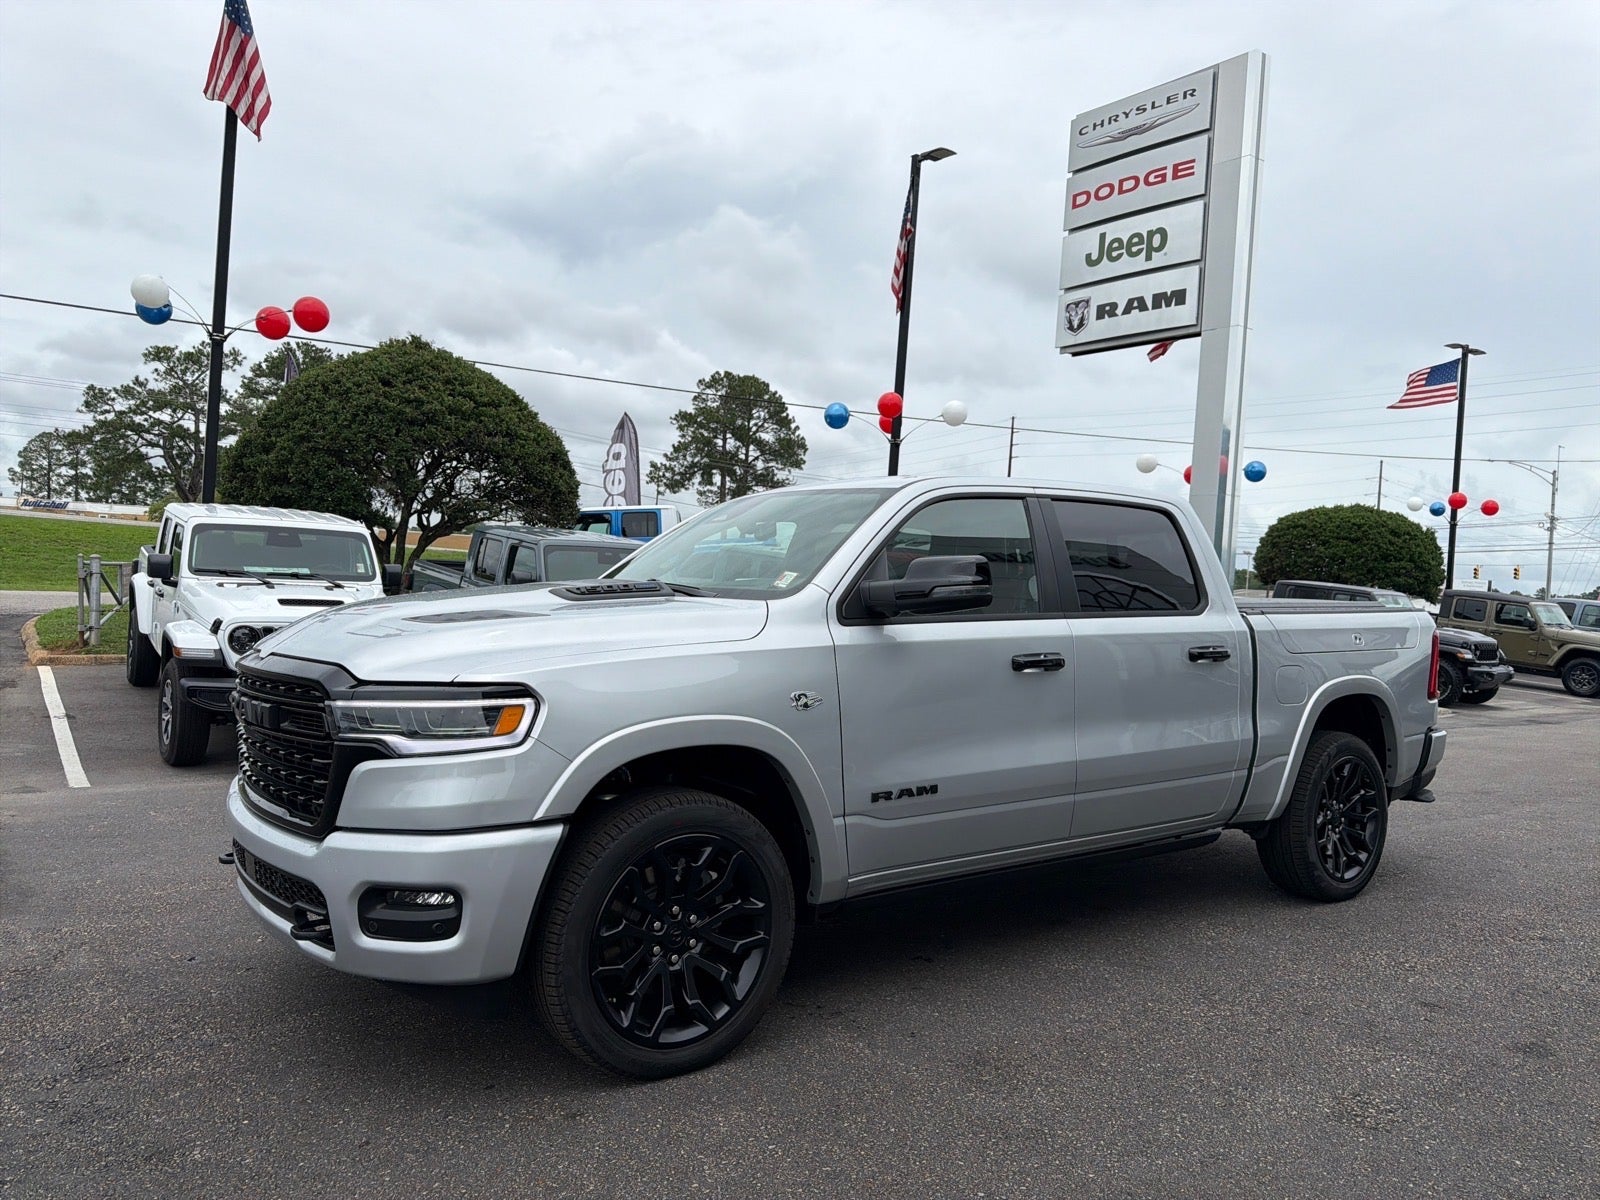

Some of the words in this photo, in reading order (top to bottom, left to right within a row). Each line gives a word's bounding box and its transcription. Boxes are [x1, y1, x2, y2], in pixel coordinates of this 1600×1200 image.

[1078, 88, 1198, 137] CHRYSLER
[1071, 158, 1197, 210] DODGE
[1084, 225, 1169, 268] Jeep
[1095, 288, 1187, 321] RAM
[870, 784, 939, 804] RAM
